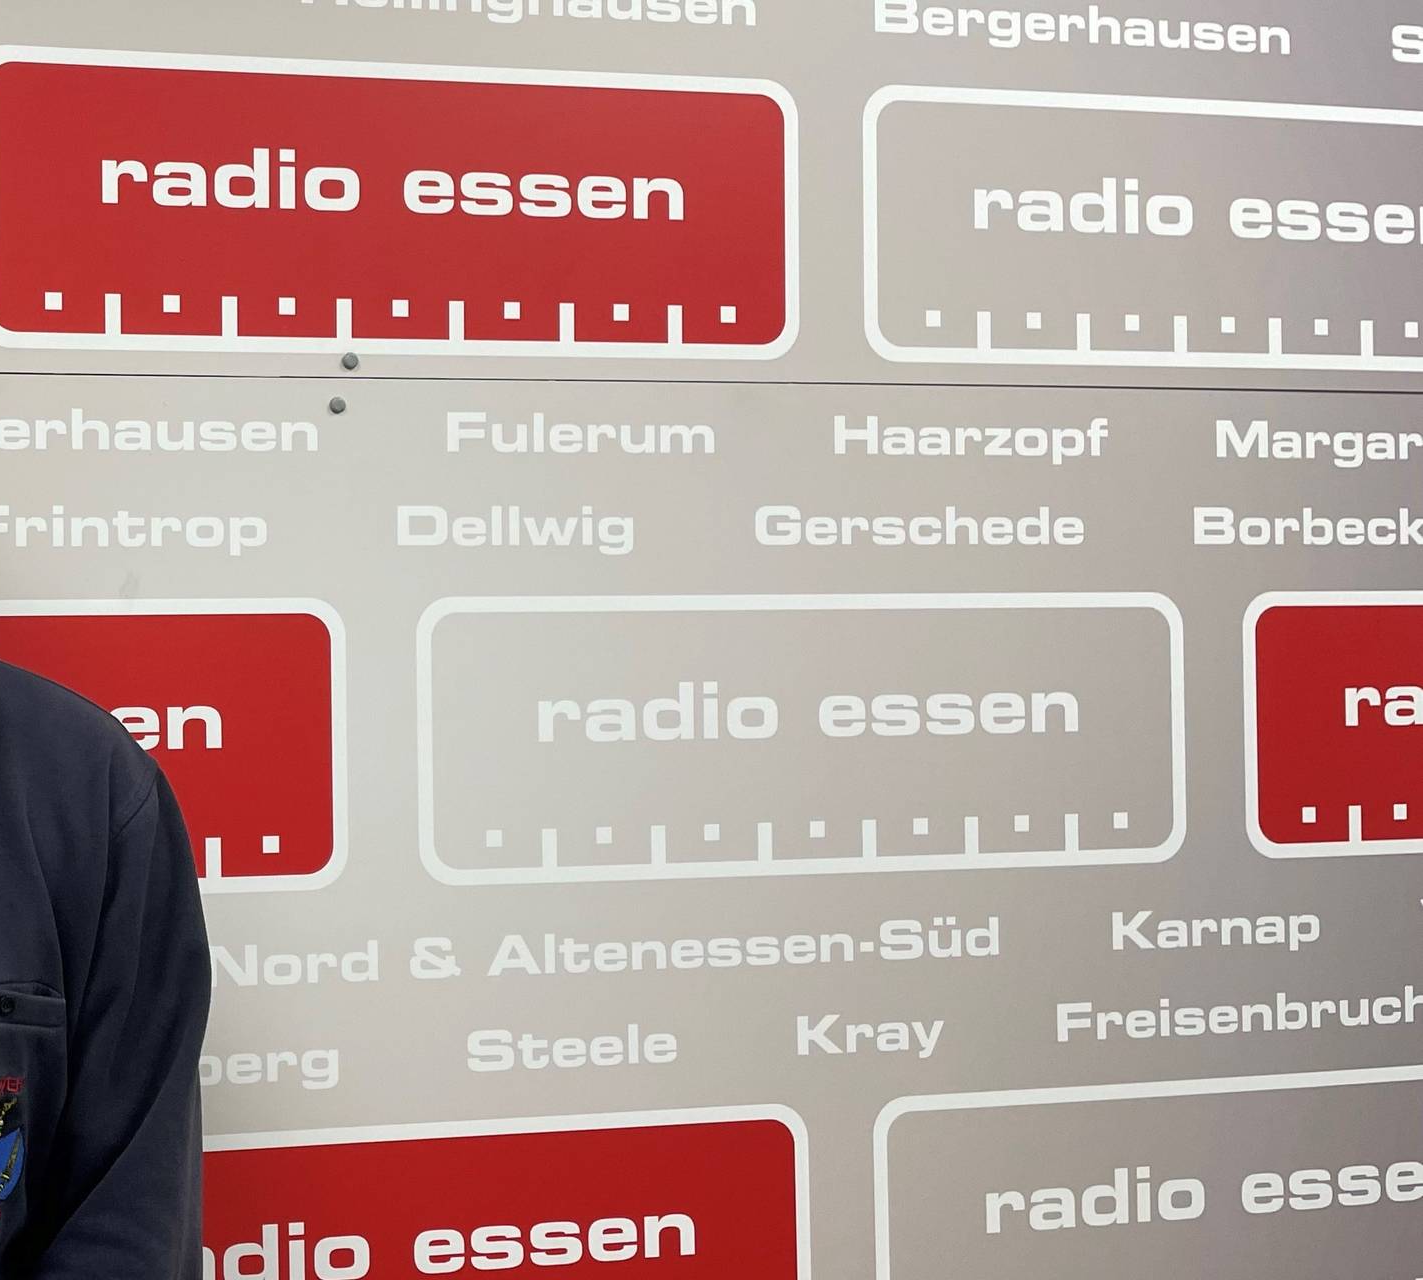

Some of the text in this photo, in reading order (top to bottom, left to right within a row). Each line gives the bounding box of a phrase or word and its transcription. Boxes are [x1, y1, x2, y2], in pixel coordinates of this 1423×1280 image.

[874, 0, 1291, 54] Bergerhausen
[101, 148, 684, 220] radio essen
[974, 178, 1423, 245] radio esse
[446, 412, 715, 454] Fulerum
[833, 415, 1109, 465] Haarzopf
[1215, 420, 1423, 468] Margar
[396, 505, 634, 555] Dellwig
[754, 505, 1085, 546] Gerschede
[1193, 507, 1423, 546] Borbeck
[537, 681, 1079, 743] radio essen
[409, 937, 462, 980] &
[486, 917, 1000, 977] Altenessen-Süd
[1111, 911, 1320, 951] Karnap
[796, 1015, 945, 1059] Kray
[1056, 985, 1423, 1043] Freisenbruch
[467, 1024, 677, 1072] Steele
[985, 1166, 1205, 1234] radio
[203, 1213, 696, 1280] dio essen
